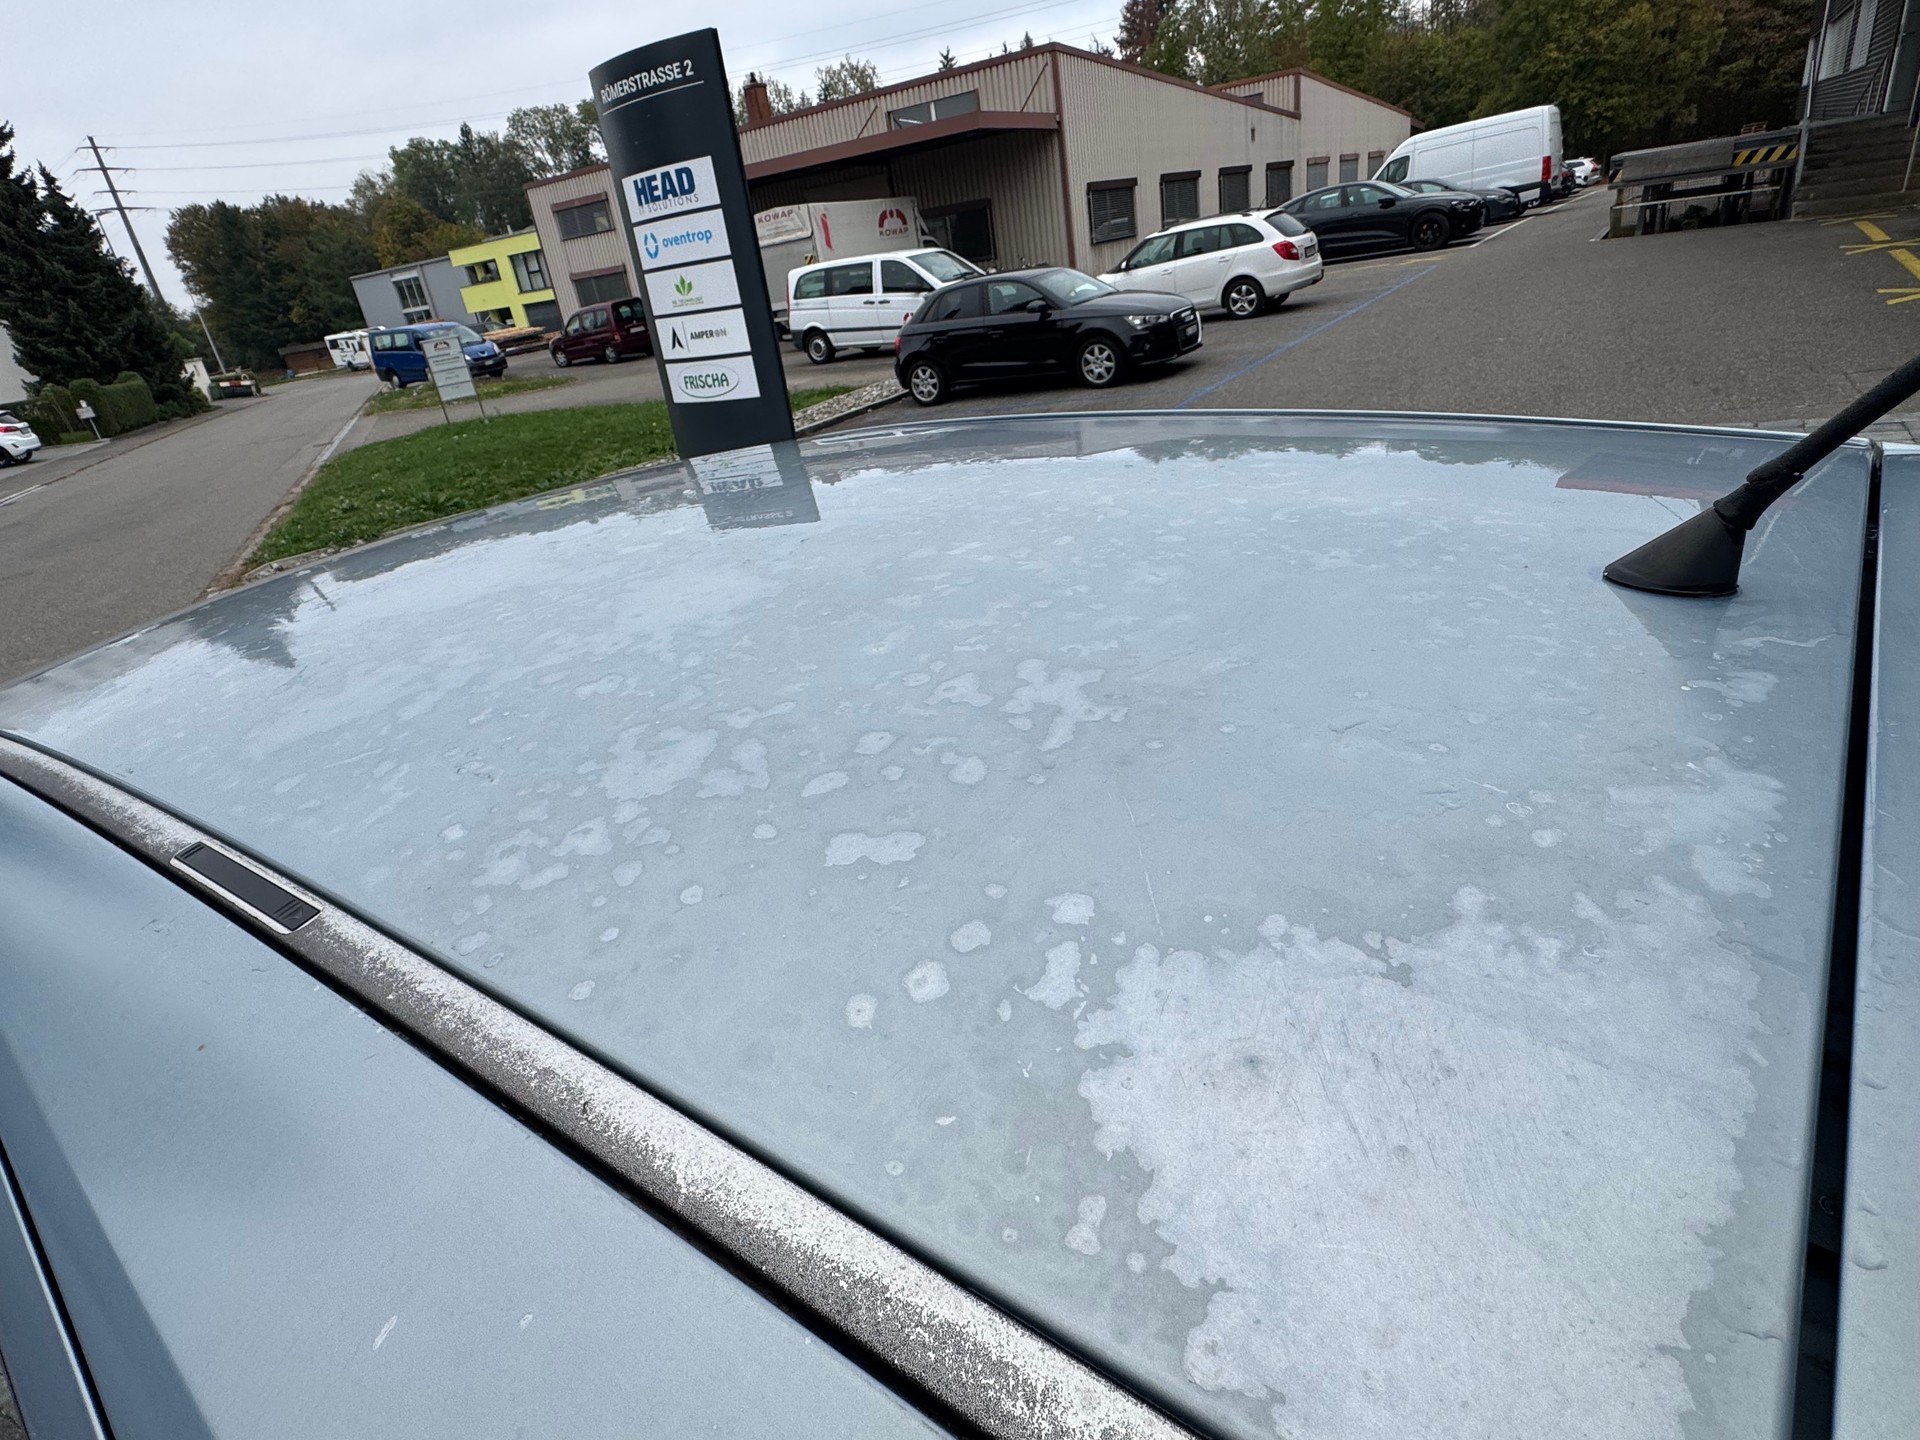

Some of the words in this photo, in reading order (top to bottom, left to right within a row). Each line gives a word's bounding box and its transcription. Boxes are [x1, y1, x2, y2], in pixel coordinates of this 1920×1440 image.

[601, 62, 682, 104] RÖMERSTRASSE
[683, 59, 694, 76] 2
[633, 167, 695, 206] HEAD
[647, 193, 699, 213] SOLUTIONS
[757, 209, 793, 224] KOWAP
[662, 229, 712, 248] oventrop
[879, 227, 909, 237] KOWAP
[684, 372, 729, 390] FRISCHA
